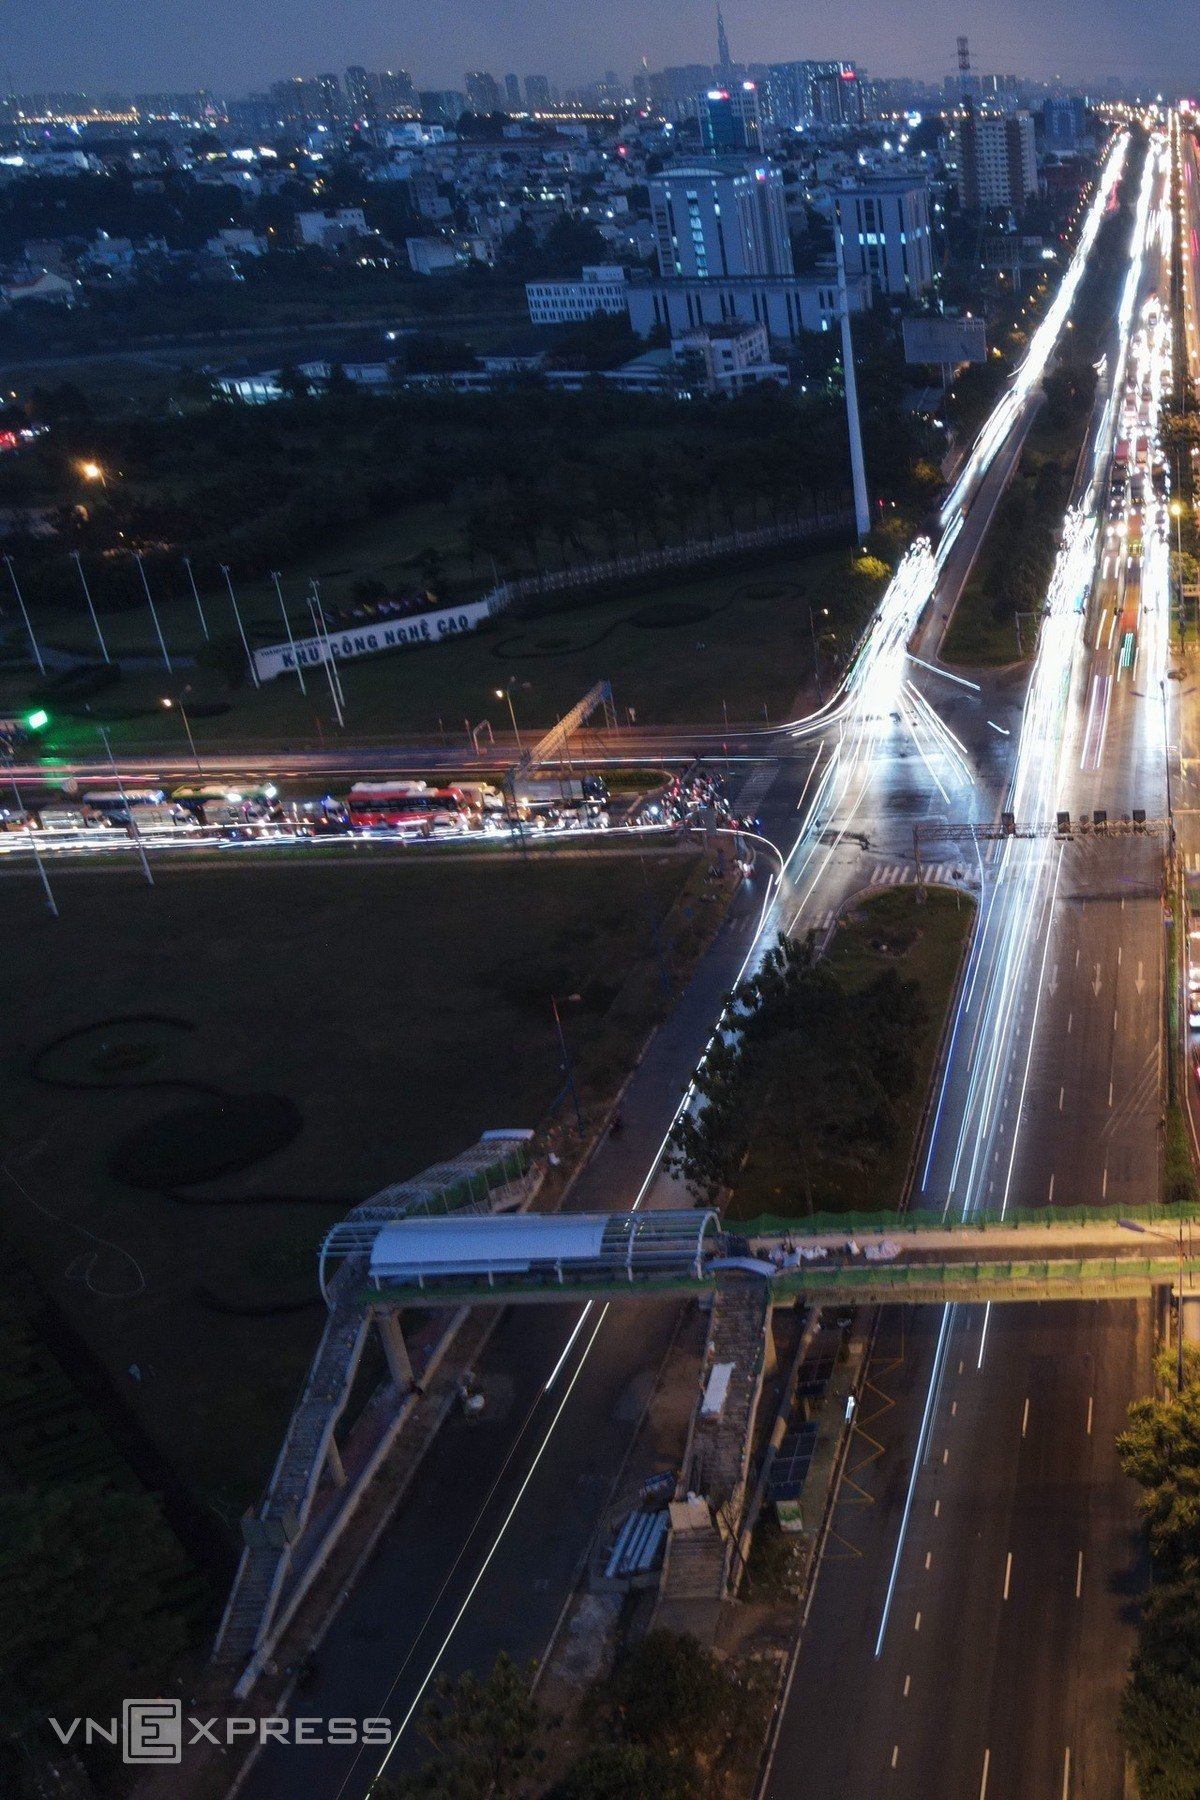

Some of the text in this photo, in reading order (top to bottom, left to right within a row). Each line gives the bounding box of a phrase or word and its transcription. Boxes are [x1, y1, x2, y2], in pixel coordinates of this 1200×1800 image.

[282, 647, 319, 668] KHU
[330, 634, 378, 657] CÔNG
[437, 614, 470, 635] CAO
